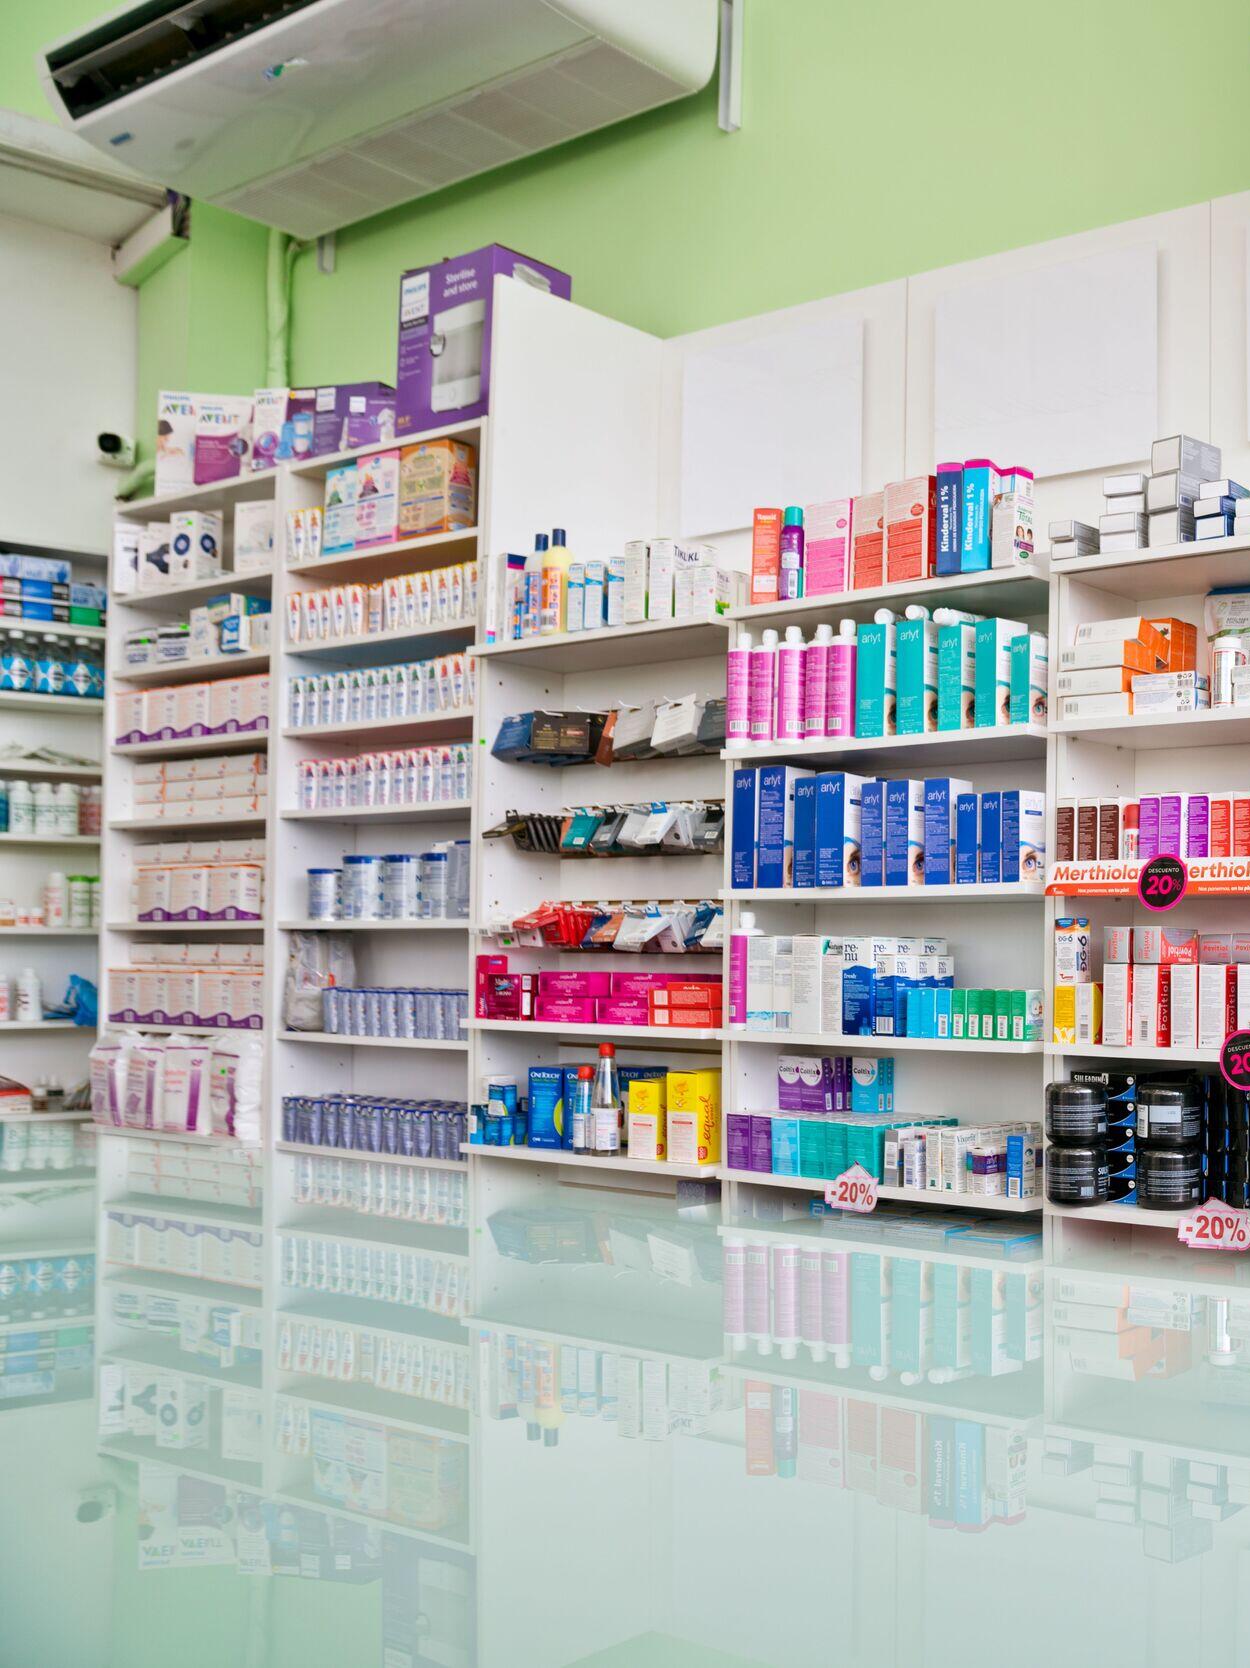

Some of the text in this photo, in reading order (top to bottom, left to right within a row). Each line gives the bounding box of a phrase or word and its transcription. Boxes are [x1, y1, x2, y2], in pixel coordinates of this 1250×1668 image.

[445, 268, 476, 285] Sterilise
[443, 280, 478, 298] and store
[162, 403, 196, 416] AVE
[200, 413, 240, 425] AVENT
[941, 485, 949, 552] Kinderval 1%
[964, 482, 975, 551] Kinderval 1%
[862, 633, 881, 645] arlyt
[900, 629, 919, 642] arlyt
[942, 638, 958, 650] arlyt
[736, 778, 752, 789] arlyt
[763, 775, 781, 787] arlyt
[797, 786, 814, 797] arlyt
[820, 782, 841, 794] arlyt
[864, 794, 880, 805] arlyt
[889, 792, 905, 803] arlyt
[927, 790, 946, 802] arlyt
[959, 802, 975, 812] arlyt
[983, 800, 999, 811] arlyt
[1054, 865, 1140, 881] Merthiola
[1146, 875, 1181, 895] 20%
[844, 953, 858, 961] nu
[830, 1180, 874, 1206] -20%
[1186, 1215, 1246, 1242] -20%
